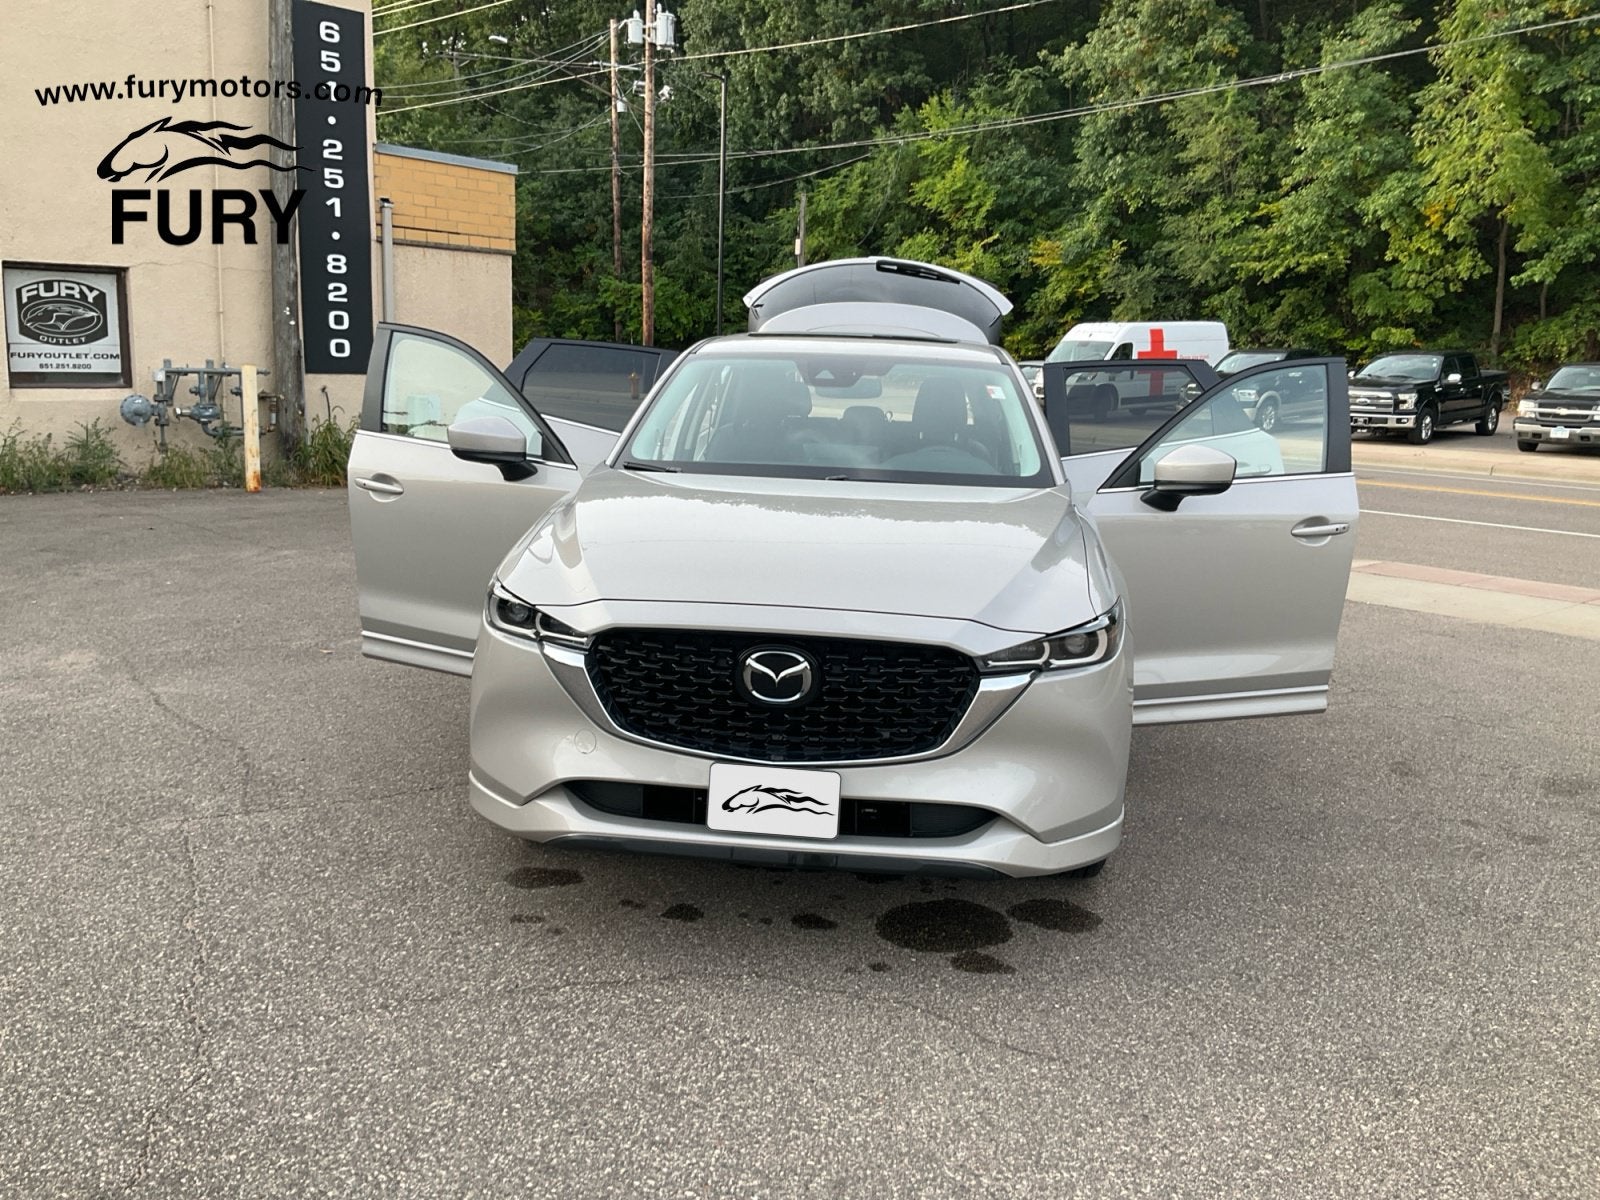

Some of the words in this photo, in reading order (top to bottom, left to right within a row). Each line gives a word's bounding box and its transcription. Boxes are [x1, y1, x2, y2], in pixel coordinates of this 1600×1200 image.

[21, 281, 101, 304] FURY
[39, 335, 86, 345] OUTLET
[10, 352, 120, 360] FURYOUTLET.COM
